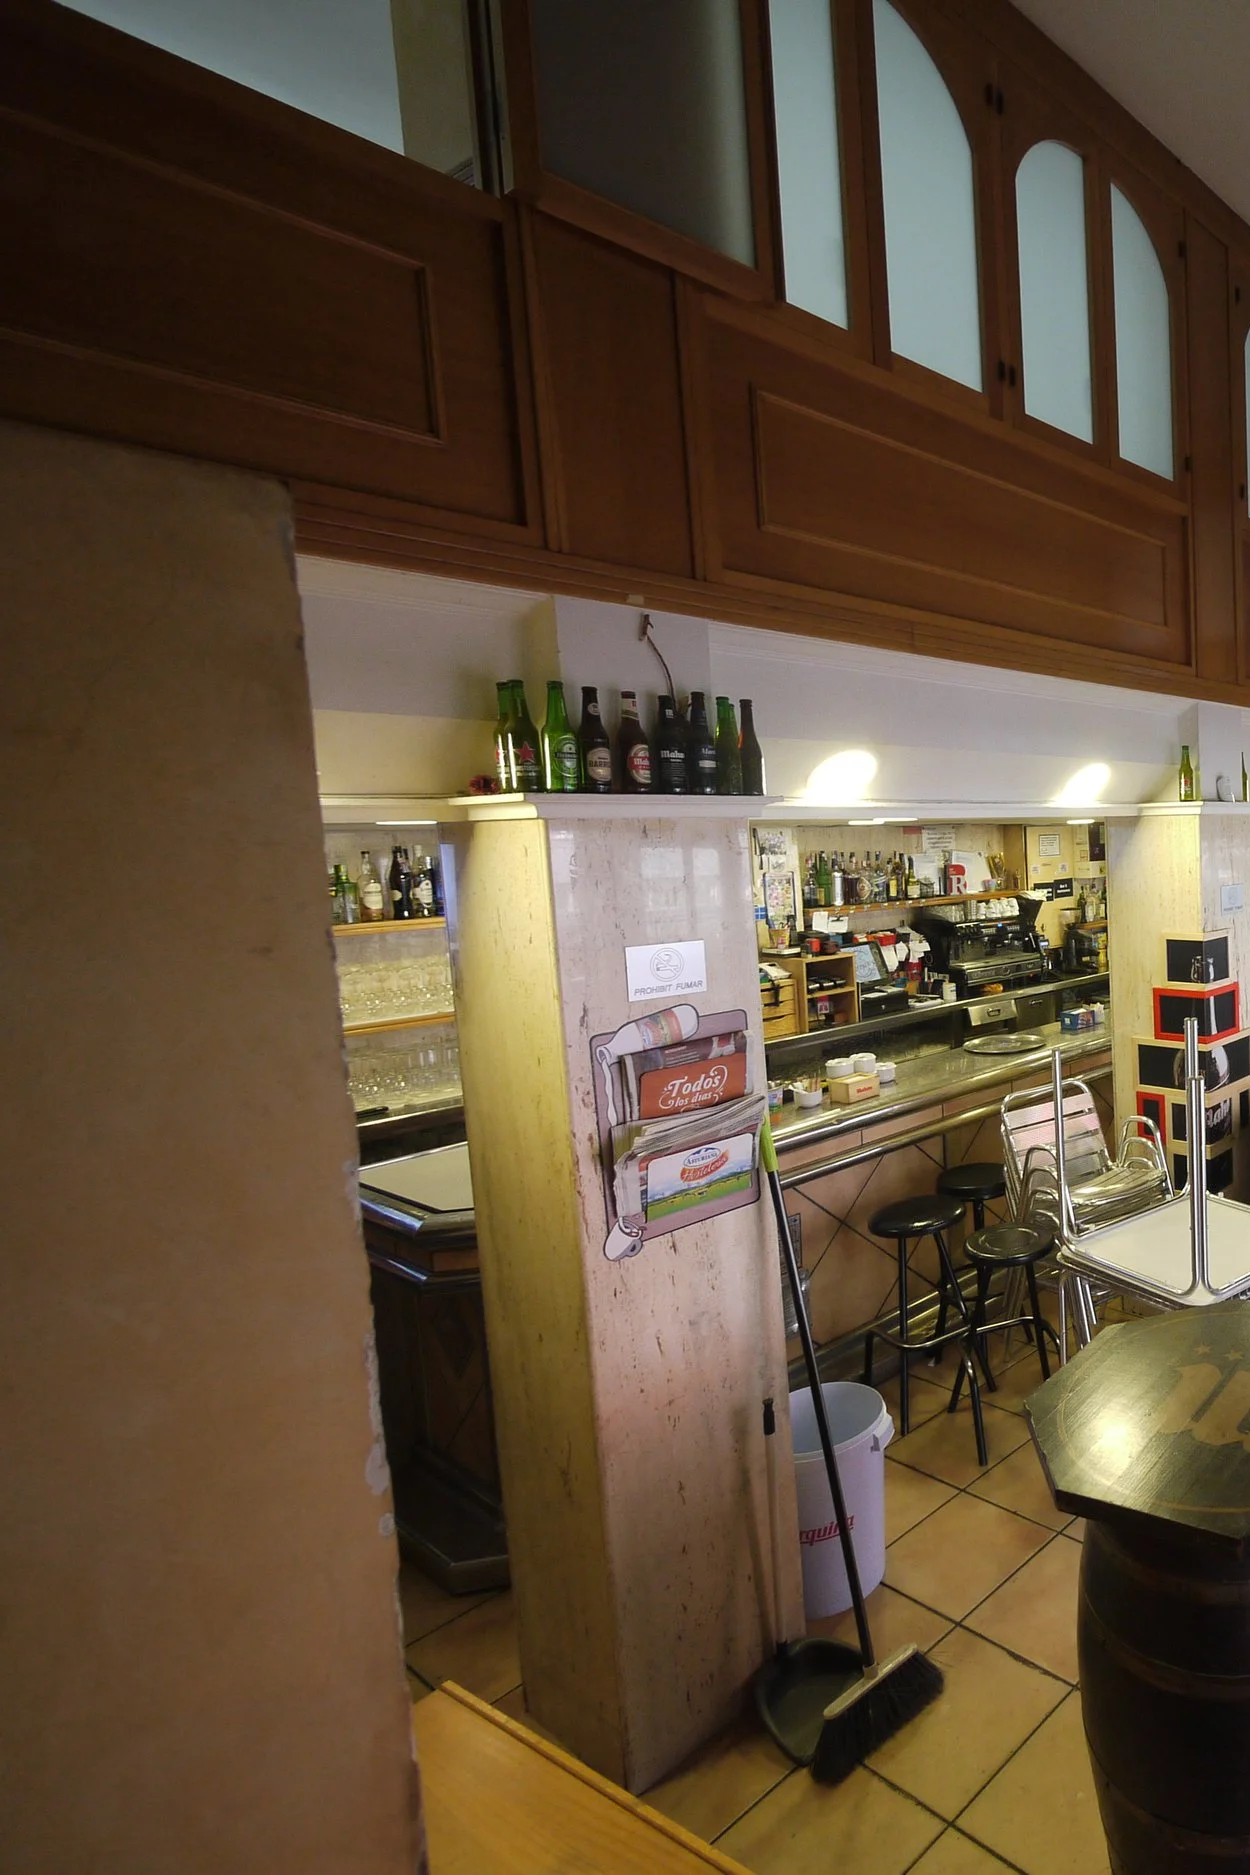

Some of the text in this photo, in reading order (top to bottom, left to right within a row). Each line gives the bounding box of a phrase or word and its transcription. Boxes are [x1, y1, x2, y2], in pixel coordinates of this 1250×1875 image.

[634, 980, 704, 997] PROHIBIT FUMAR
[667, 1070, 724, 1098] Todos
[675, 1096, 689, 1107] los
